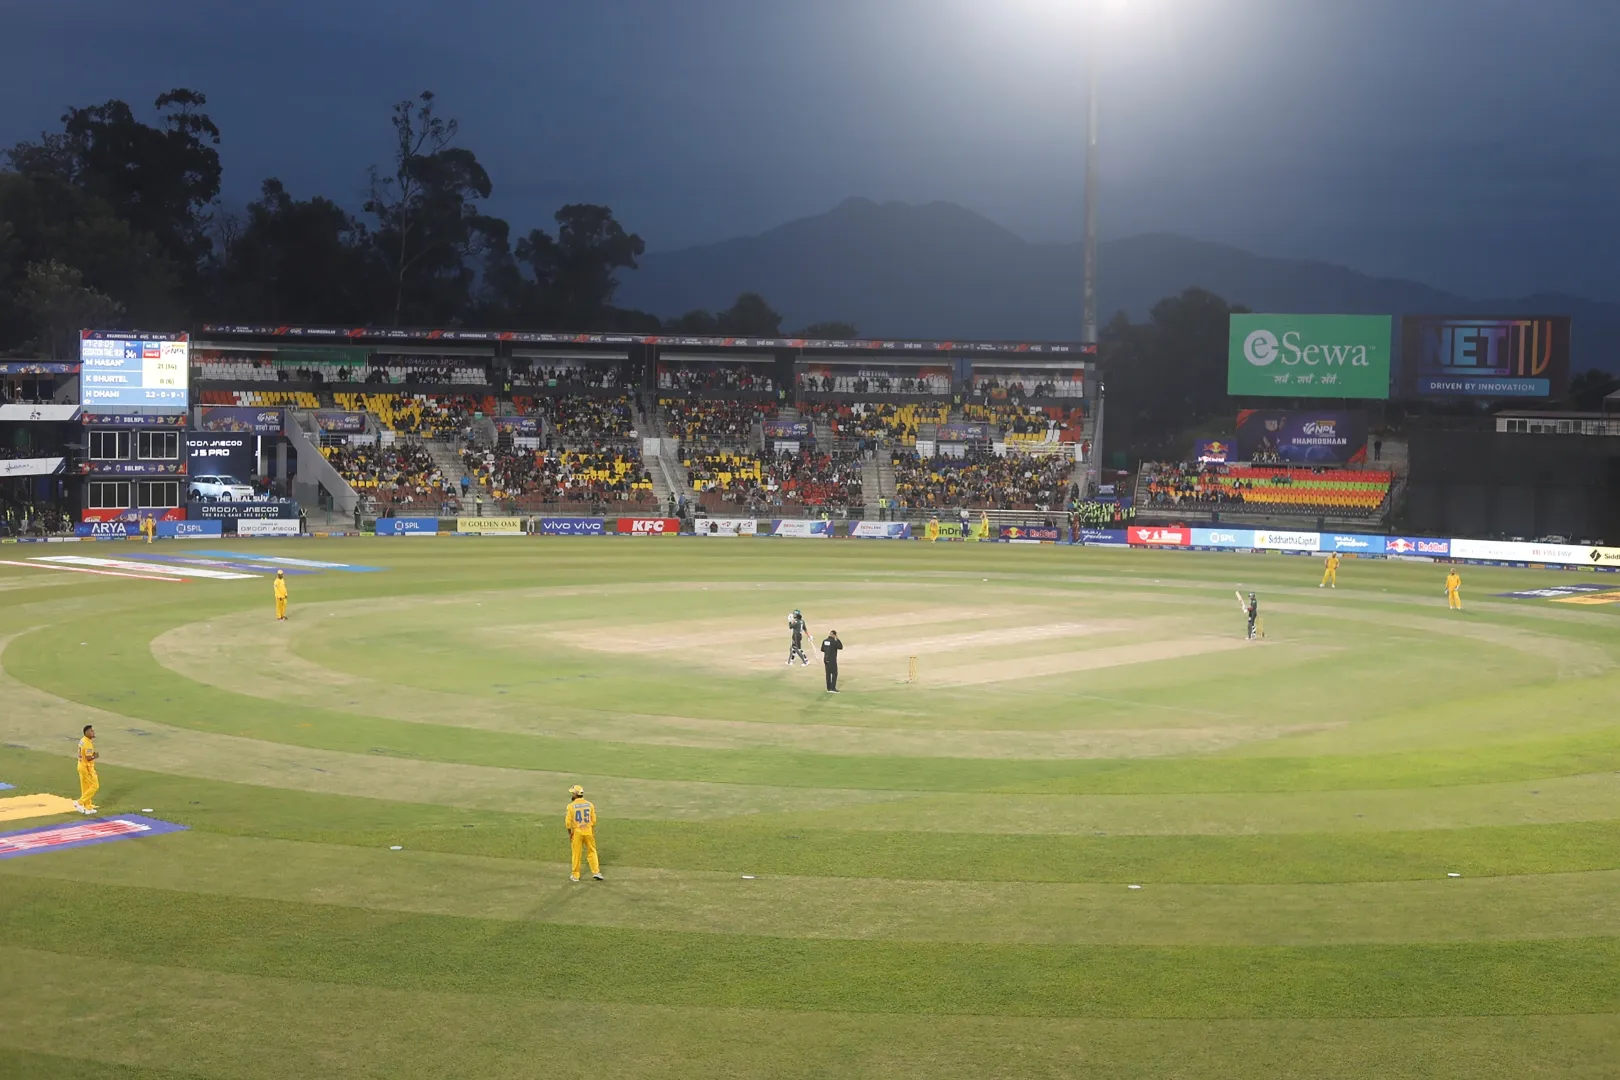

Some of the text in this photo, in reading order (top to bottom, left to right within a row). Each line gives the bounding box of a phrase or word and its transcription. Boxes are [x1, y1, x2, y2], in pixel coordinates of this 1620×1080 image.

[1244, 329, 1369, 367] eSewa
[1515, 320, 1552, 376] TV
[1315, 425, 1335, 434] NPL
[92, 522, 126, 533] ARYA
[544, 522, 600, 530] vivo vivo
[632, 520, 664, 531] KFC
[940, 526, 972, 536] inDrie
[1030, 529, 1058, 538] Red Bull
[1268, 534, 1316, 547] Siddhartha Capital
[1418, 542, 1432, 551] Red
[1433, 542, 1448, 552] Bull
[575, 808, 590, 823] 45
